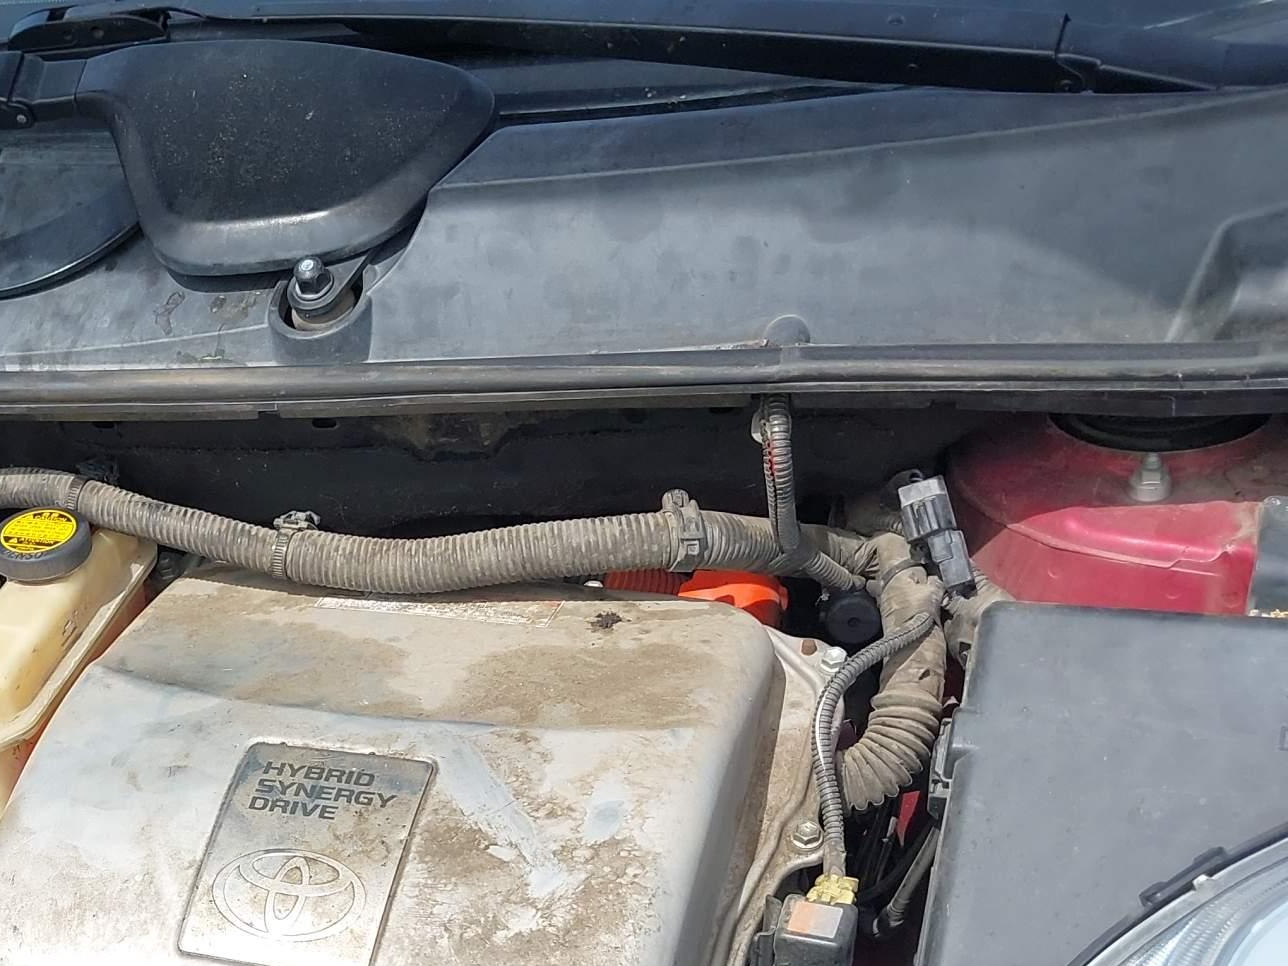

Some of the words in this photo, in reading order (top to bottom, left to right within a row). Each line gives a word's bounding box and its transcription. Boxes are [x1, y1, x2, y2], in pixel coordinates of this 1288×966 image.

[262, 761, 376, 787] HYBRID
[255, 778, 398, 809] SYNERGY
[248, 796, 339, 821] DRIVE
